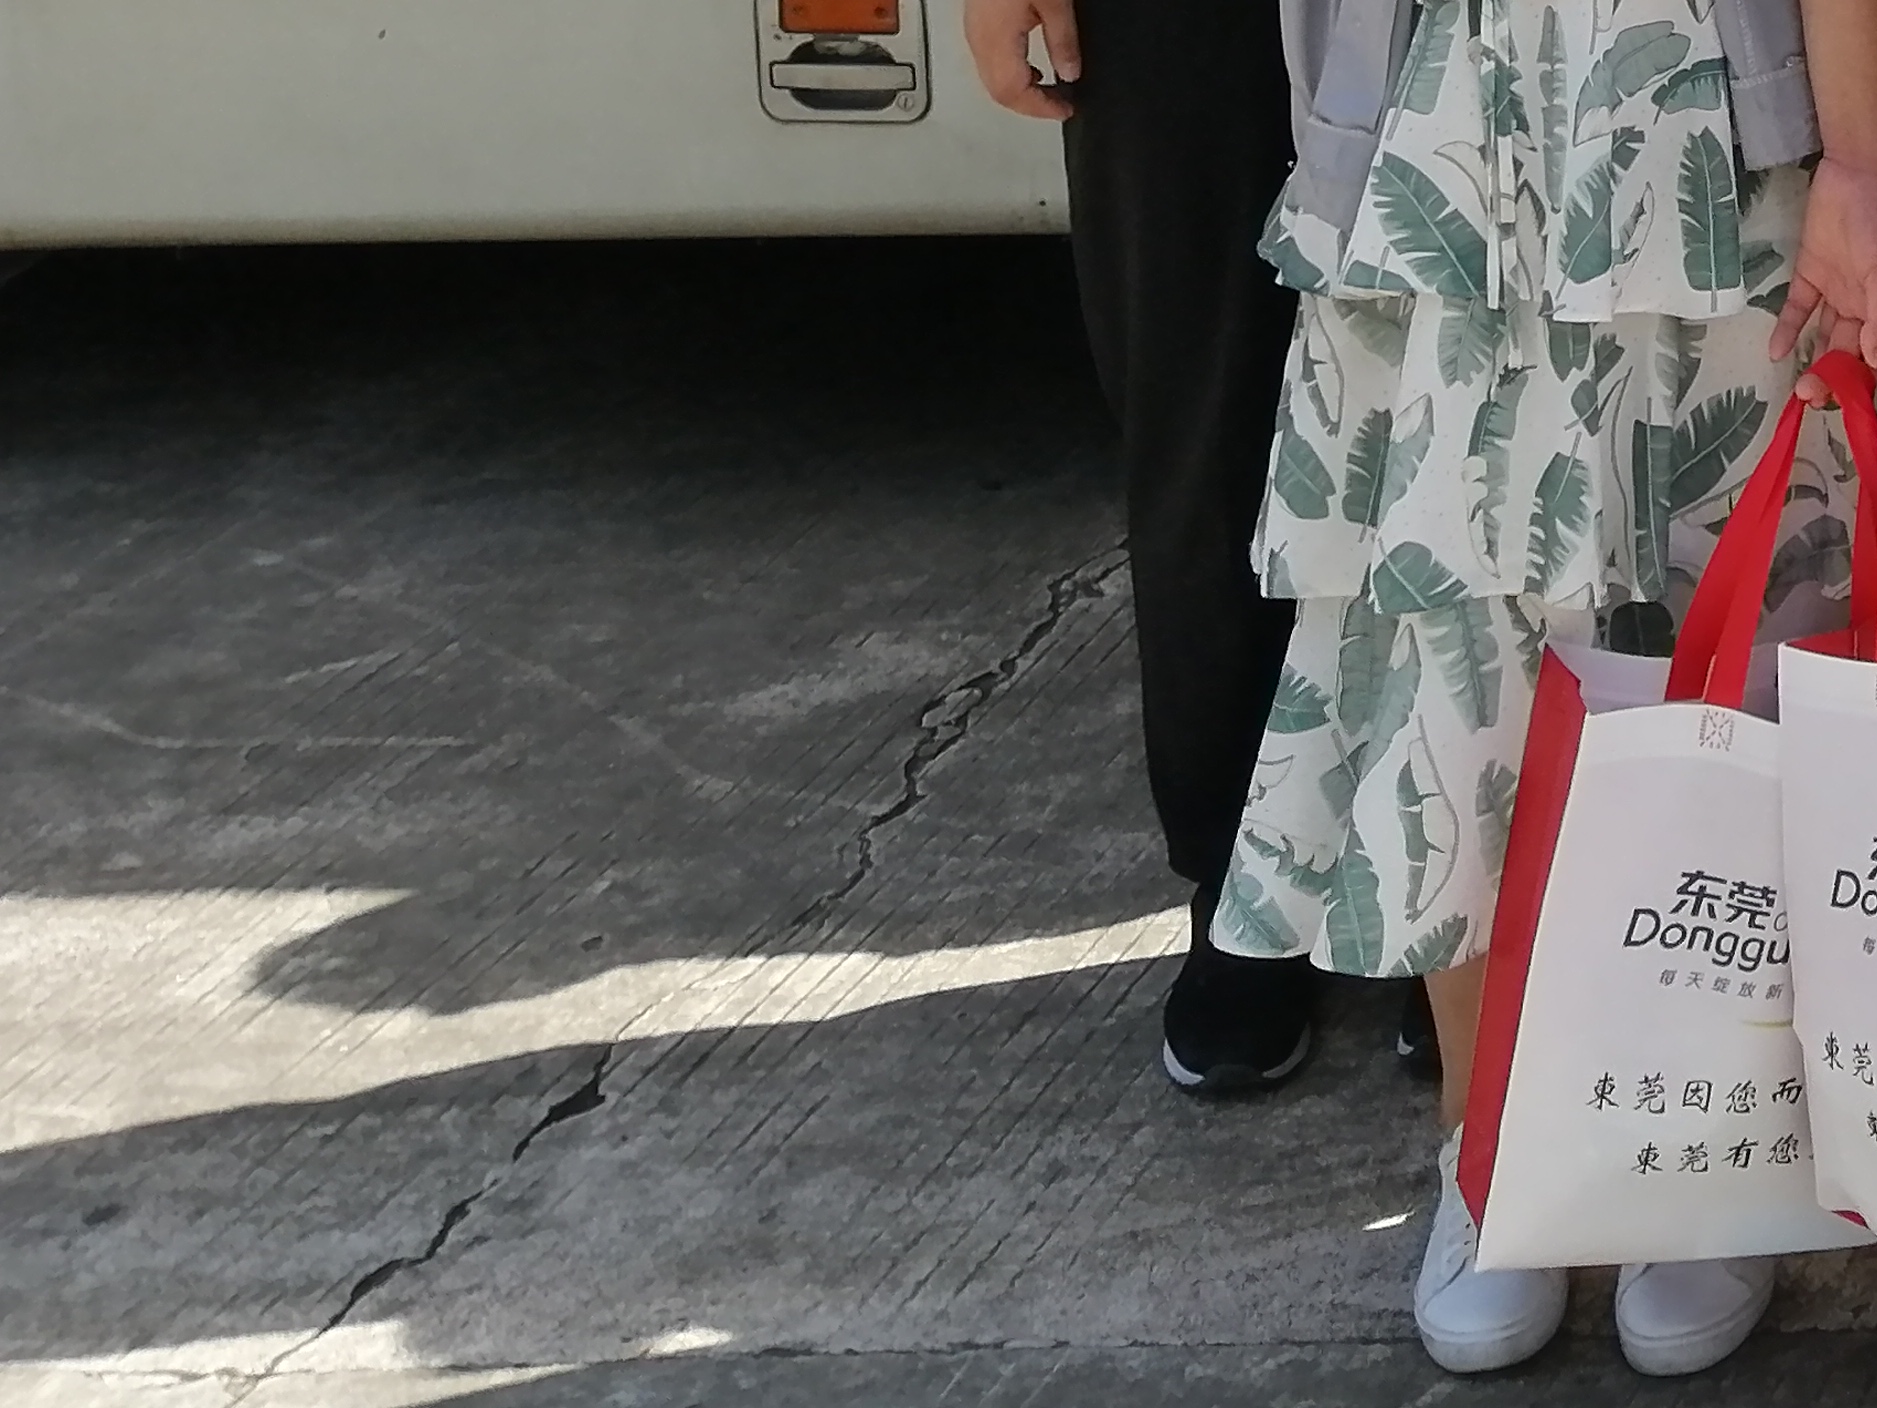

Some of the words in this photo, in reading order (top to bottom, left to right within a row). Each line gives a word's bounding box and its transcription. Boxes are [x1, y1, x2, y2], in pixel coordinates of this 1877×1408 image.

[1668, 869, 1778, 931] 东莞
[1631, 1132, 1815, 1175] 東莞有您
